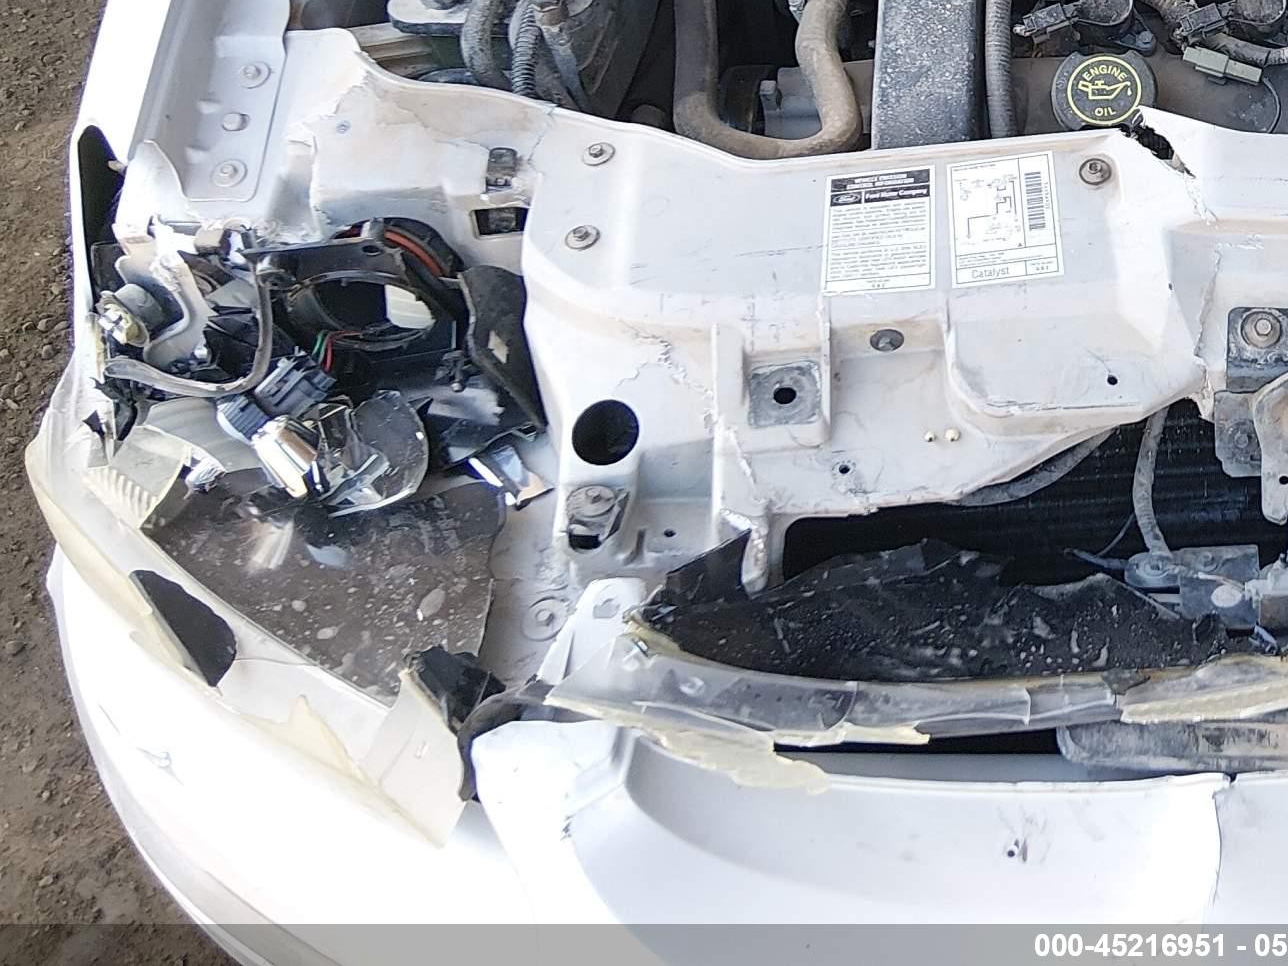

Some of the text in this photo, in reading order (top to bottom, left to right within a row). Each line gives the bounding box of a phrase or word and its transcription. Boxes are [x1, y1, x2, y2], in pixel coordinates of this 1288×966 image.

[1082, 65, 1128, 81] ENGINE
[1094, 107, 1117, 116] OIL
[971, 266, 1010, 280] Catalyst
